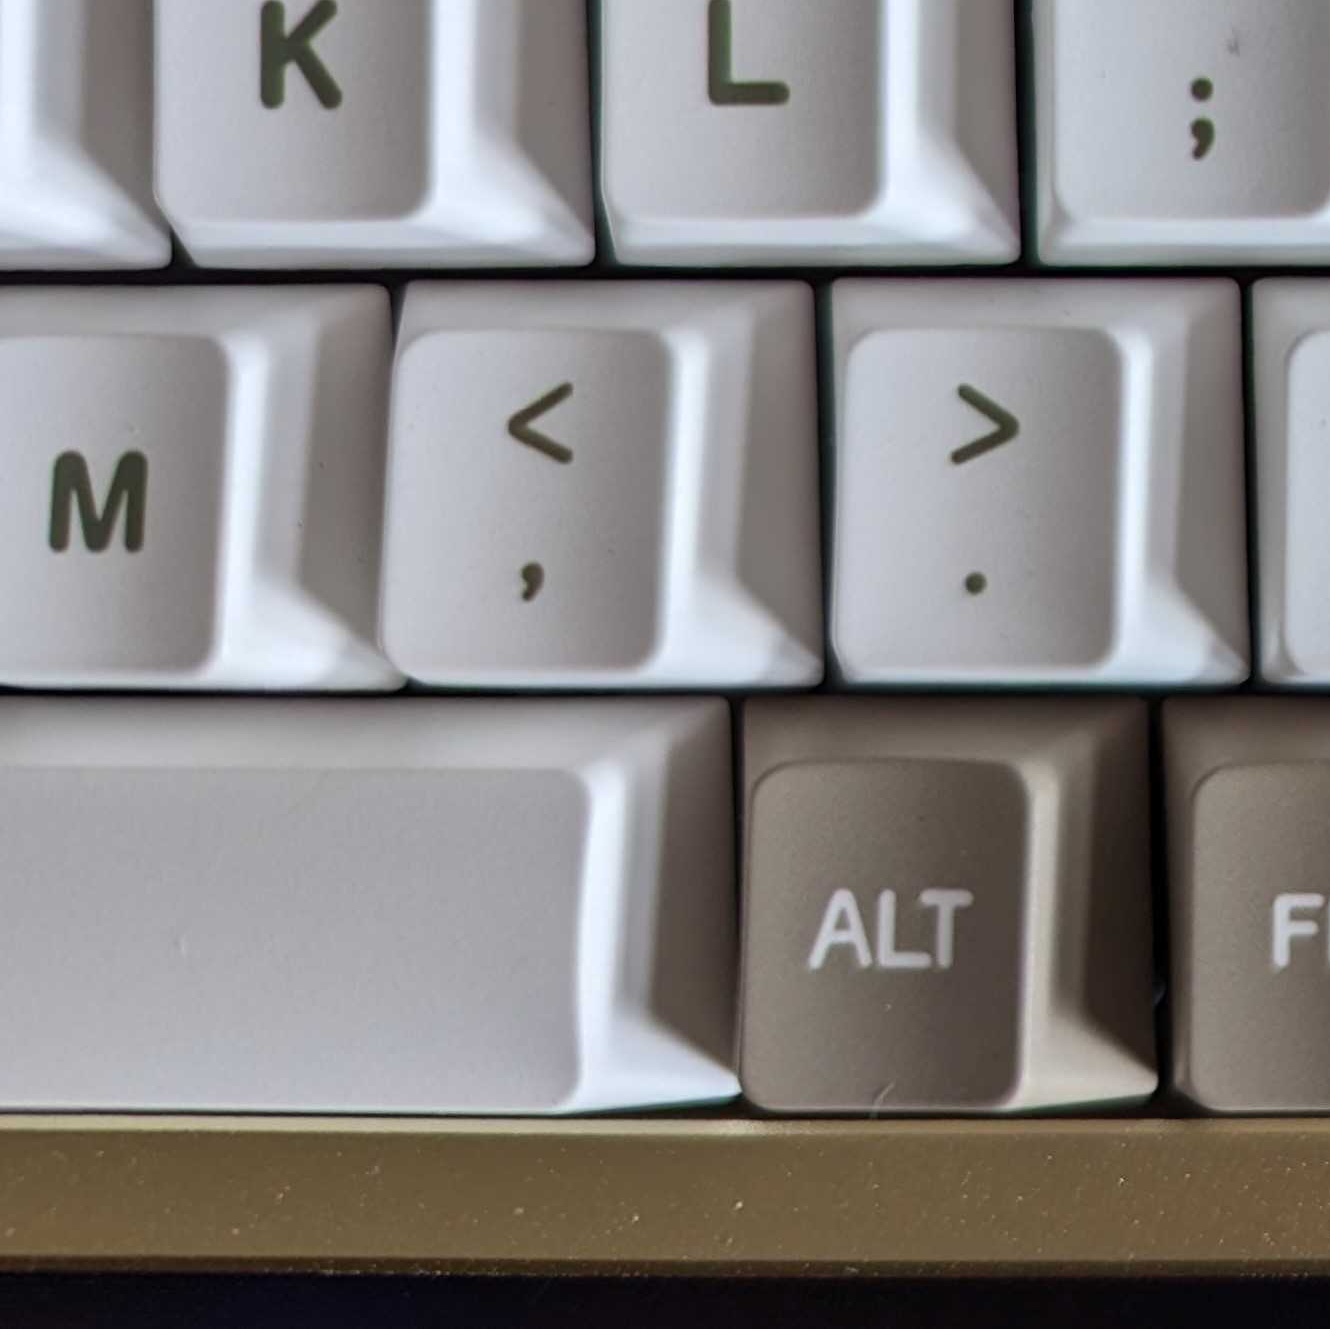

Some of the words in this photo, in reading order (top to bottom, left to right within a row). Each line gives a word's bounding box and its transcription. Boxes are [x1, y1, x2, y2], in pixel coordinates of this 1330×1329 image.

[1189, 76, 1216, 161] ;
[506, 381, 574, 466] <
[950, 384, 1021, 466] >
[48, 449, 149, 554] M
[806, 887, 975, 971] ALT
